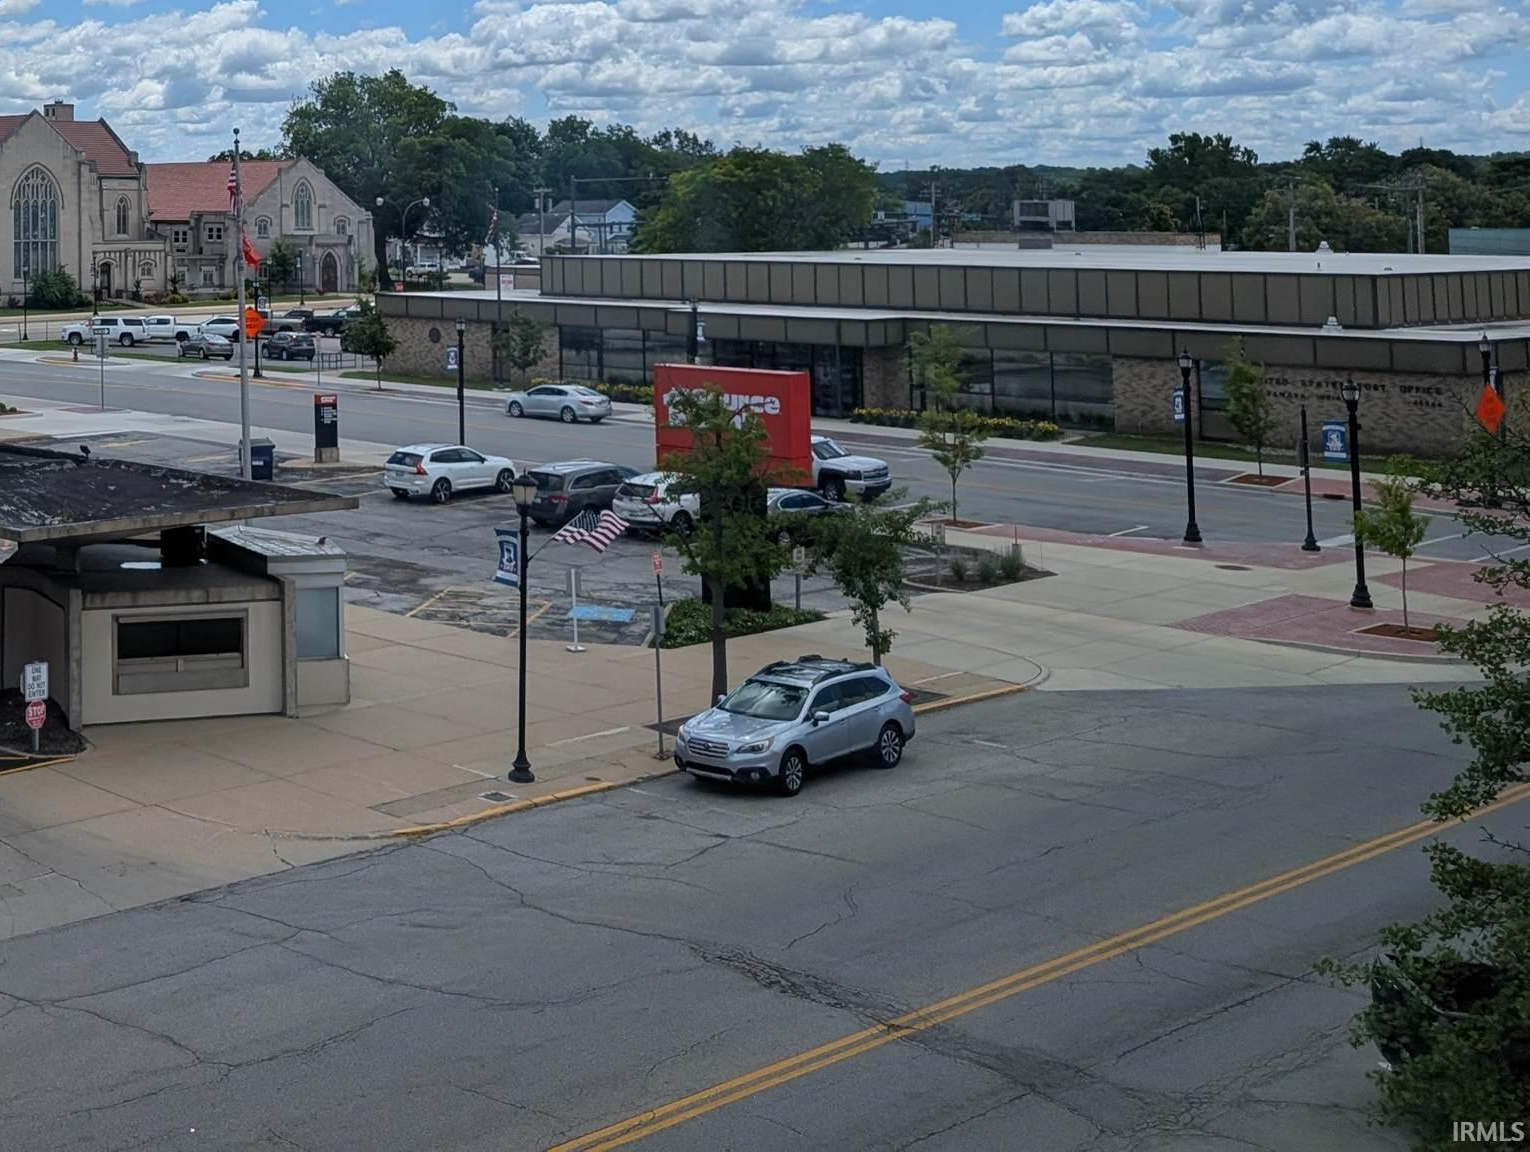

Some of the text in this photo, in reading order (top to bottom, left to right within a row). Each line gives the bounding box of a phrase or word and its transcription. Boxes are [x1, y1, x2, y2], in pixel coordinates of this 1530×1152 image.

[1399, 385, 1444, 395] OFFICE
[31, 666, 42, 674] ONE
[27, 681, 46, 690] DO NOT
[28, 689, 46, 698] ENTER
[28, 705, 45, 717] STOP
